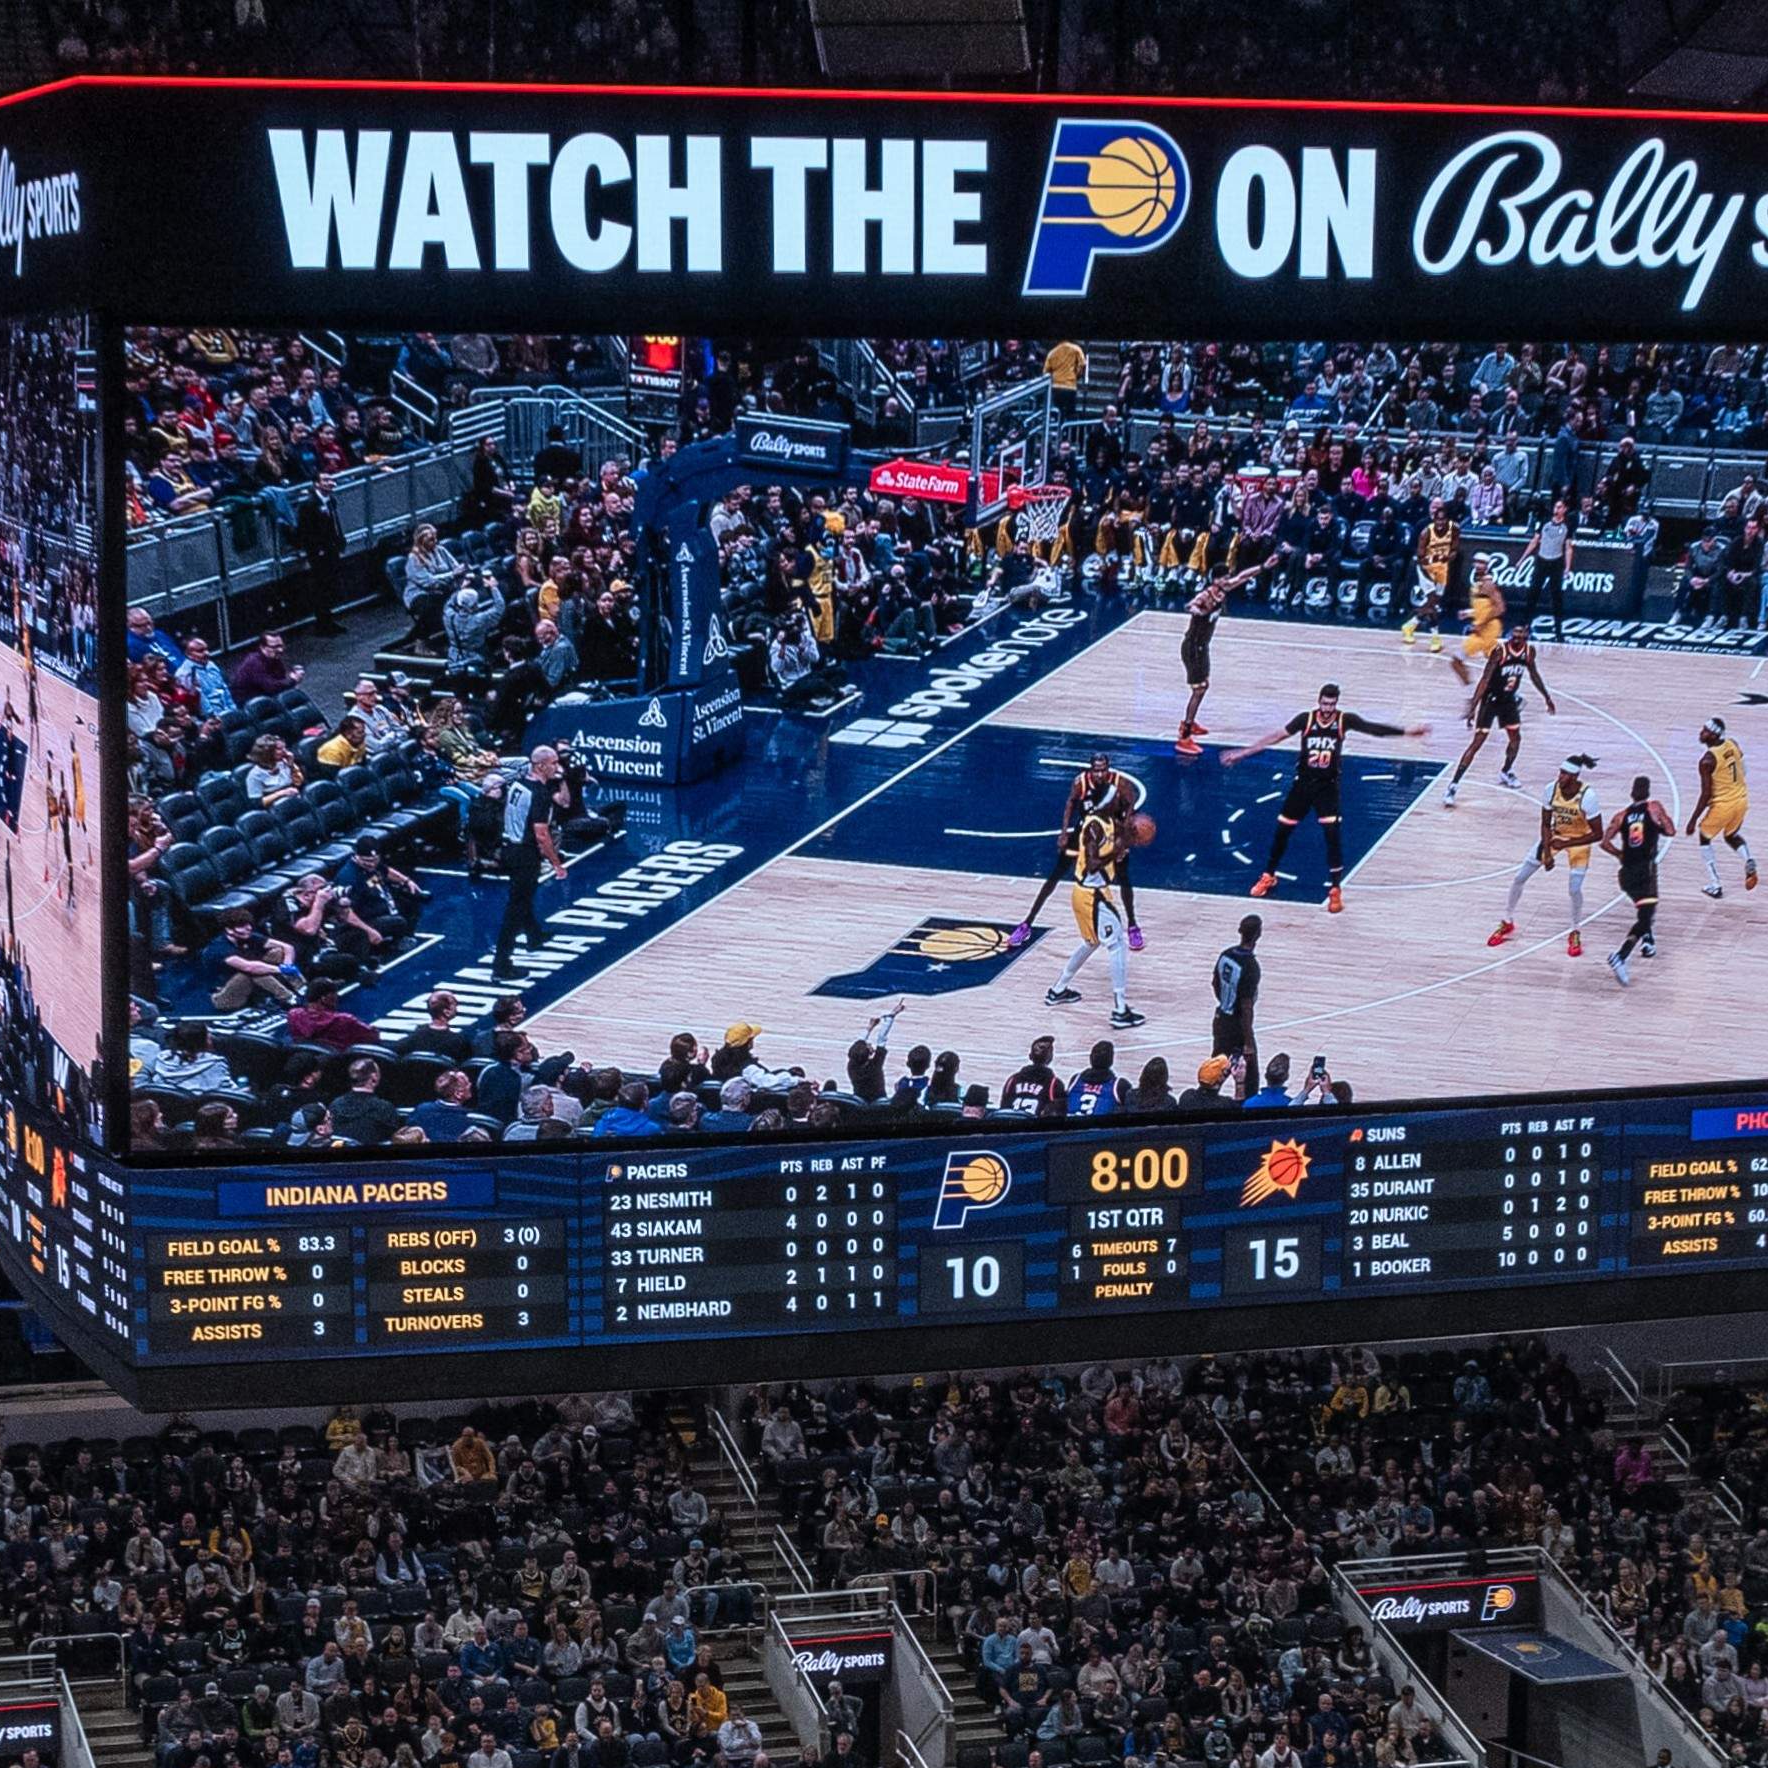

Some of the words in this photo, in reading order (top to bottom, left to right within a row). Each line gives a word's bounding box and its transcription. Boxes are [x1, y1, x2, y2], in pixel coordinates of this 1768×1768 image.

[27, 172, 80, 239] SPORTS
[270, 128, 722, 273] WATCH
[751, 138, 988, 276] THE
[1217, 148, 1375, 280] ON
[1410, 131, 1743, 312] Bally
[751, 432, 794, 457] Bally
[794, 443, 826, 459] SPORTS
[895, 473, 959, 493] StateFarm
[573, 732, 662, 754] Ascension
[597, 754, 663, 777] Vincent
[1367, 1127, 1405, 1142] SUNS
[1091, 1147, 1189, 1192] 8:00
[1374, 1153, 1421, 1170] ALLEN
[1650, 1164, 1686, 1178] FIELD
[1690, 1161, 1724, 1175] GOAL
[627, 1164, 687, 1180] PACERS
[266, 1186, 357, 1206] INDIANA
[363, 1181, 447, 1201] PACERS
[1373, 1178, 1434, 1197] DURANT
[1645, 1190, 1677, 1204] FREE
[1680, 1187, 1728, 1202] THROW
[611, 1195, 632, 1211] 23
[636, 1191, 712, 1209] NESMITH
[1087, 1210, 1121, 1230] 1ST
[1126, 1207, 1163, 1229] QTR
[1372, 1206, 1429, 1223] NURKIC
[1648, 1215, 1703, 1230] 3-POINT
[611, 1223, 632, 1238] 43
[636, 1220, 702, 1237] SIAKAM
[168, 1241, 216, 1257] FIELD
[219, 1240, 263, 1254] GOAL
[299, 1237, 335, 1251] 83.3
[388, 1232, 430, 1248] REBS
[434, 1230, 477, 1249] (OFF)
[1092, 1239, 1158, 1256] TIMEOUTS
[1371, 1234, 1409, 1250] BEAL
[611, 1250, 632, 1266] 33
[637, 1247, 704, 1265] TURNER
[1249, 1238, 1299, 1279] 15
[401, 1260, 465, 1275] BLOCKS
[1103, 1261, 1146, 1277] FOULS
[1371, 1258, 1431, 1276] BOOKER
[164, 1270, 206, 1286] FREE
[209, 1268, 270, 1283] THROW
[638, 1276, 686, 1292] HIELD
[946, 1256, 1000, 1299] 10
[403, 1287, 464, 1303] STEALS
[1095, 1282, 1153, 1298] PENALTY
[170, 1297, 239, 1314] 3-POINT
[243, 1296, 265, 1311] FG
[638, 1301, 731, 1320] NEMBHARD
[192, 1324, 262, 1341] ASSISTS
[385, 1315, 483, 1332] TURNOVERS
[1370, 1597, 1429, 1624] Bally
[1429, 1600, 1469, 1615] SPORTS
[844, 1653, 885, 1668] SPORTS
[6, 1724, 52, 1739] SPORTS
